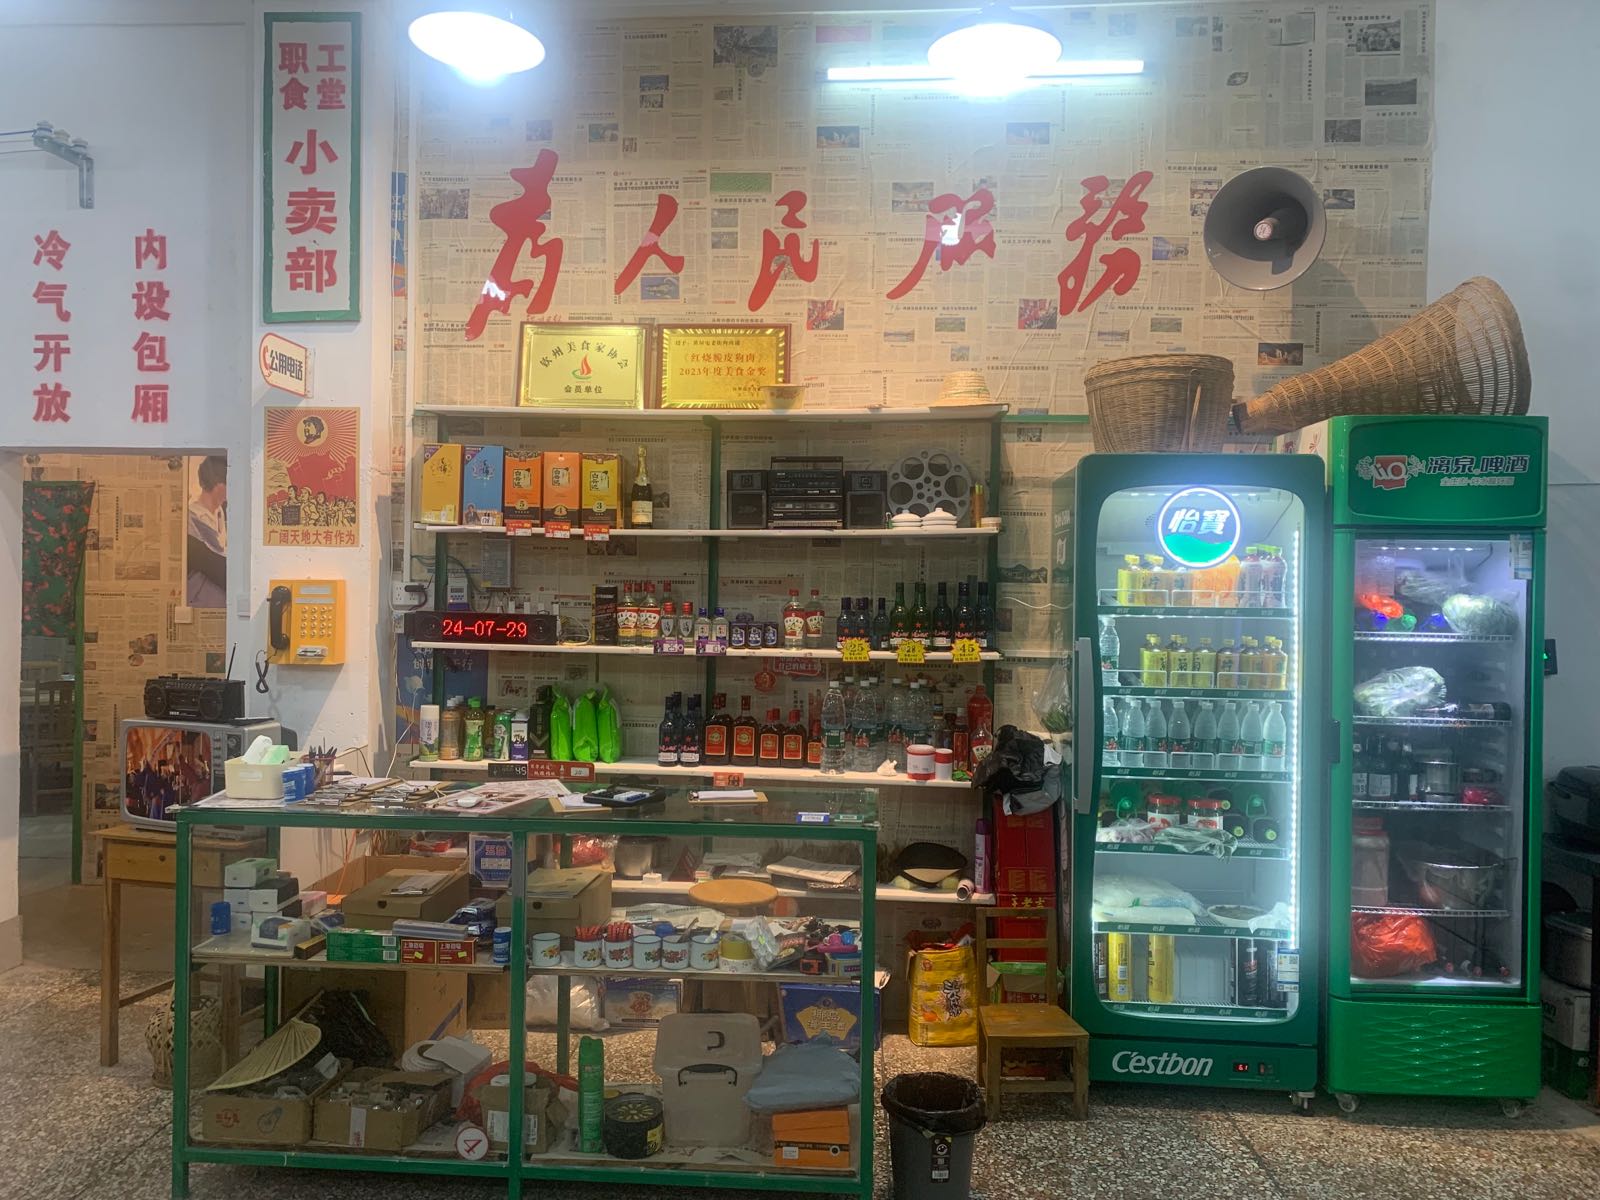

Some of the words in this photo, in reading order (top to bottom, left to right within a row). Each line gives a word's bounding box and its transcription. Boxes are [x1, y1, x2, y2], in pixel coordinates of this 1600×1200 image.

[278, 42, 347, 75] 职工
[278, 77, 347, 111] 食堂
[284, 129, 339, 293] 小卖部
[32, 229, 72, 423] 冷气开放
[131, 228, 171, 423] 内设包厢
[269, 349, 303, 382] 公用电话
[539, 340, 630, 369] 钦州美食家协会
[679, 366, 767, 377] 2023年度美食金奖
[563, 384, 604, 394] 会员单位
[267, 528, 356, 545] 广阔天地大有作为
[442, 619, 528, 638] 24-07-29
